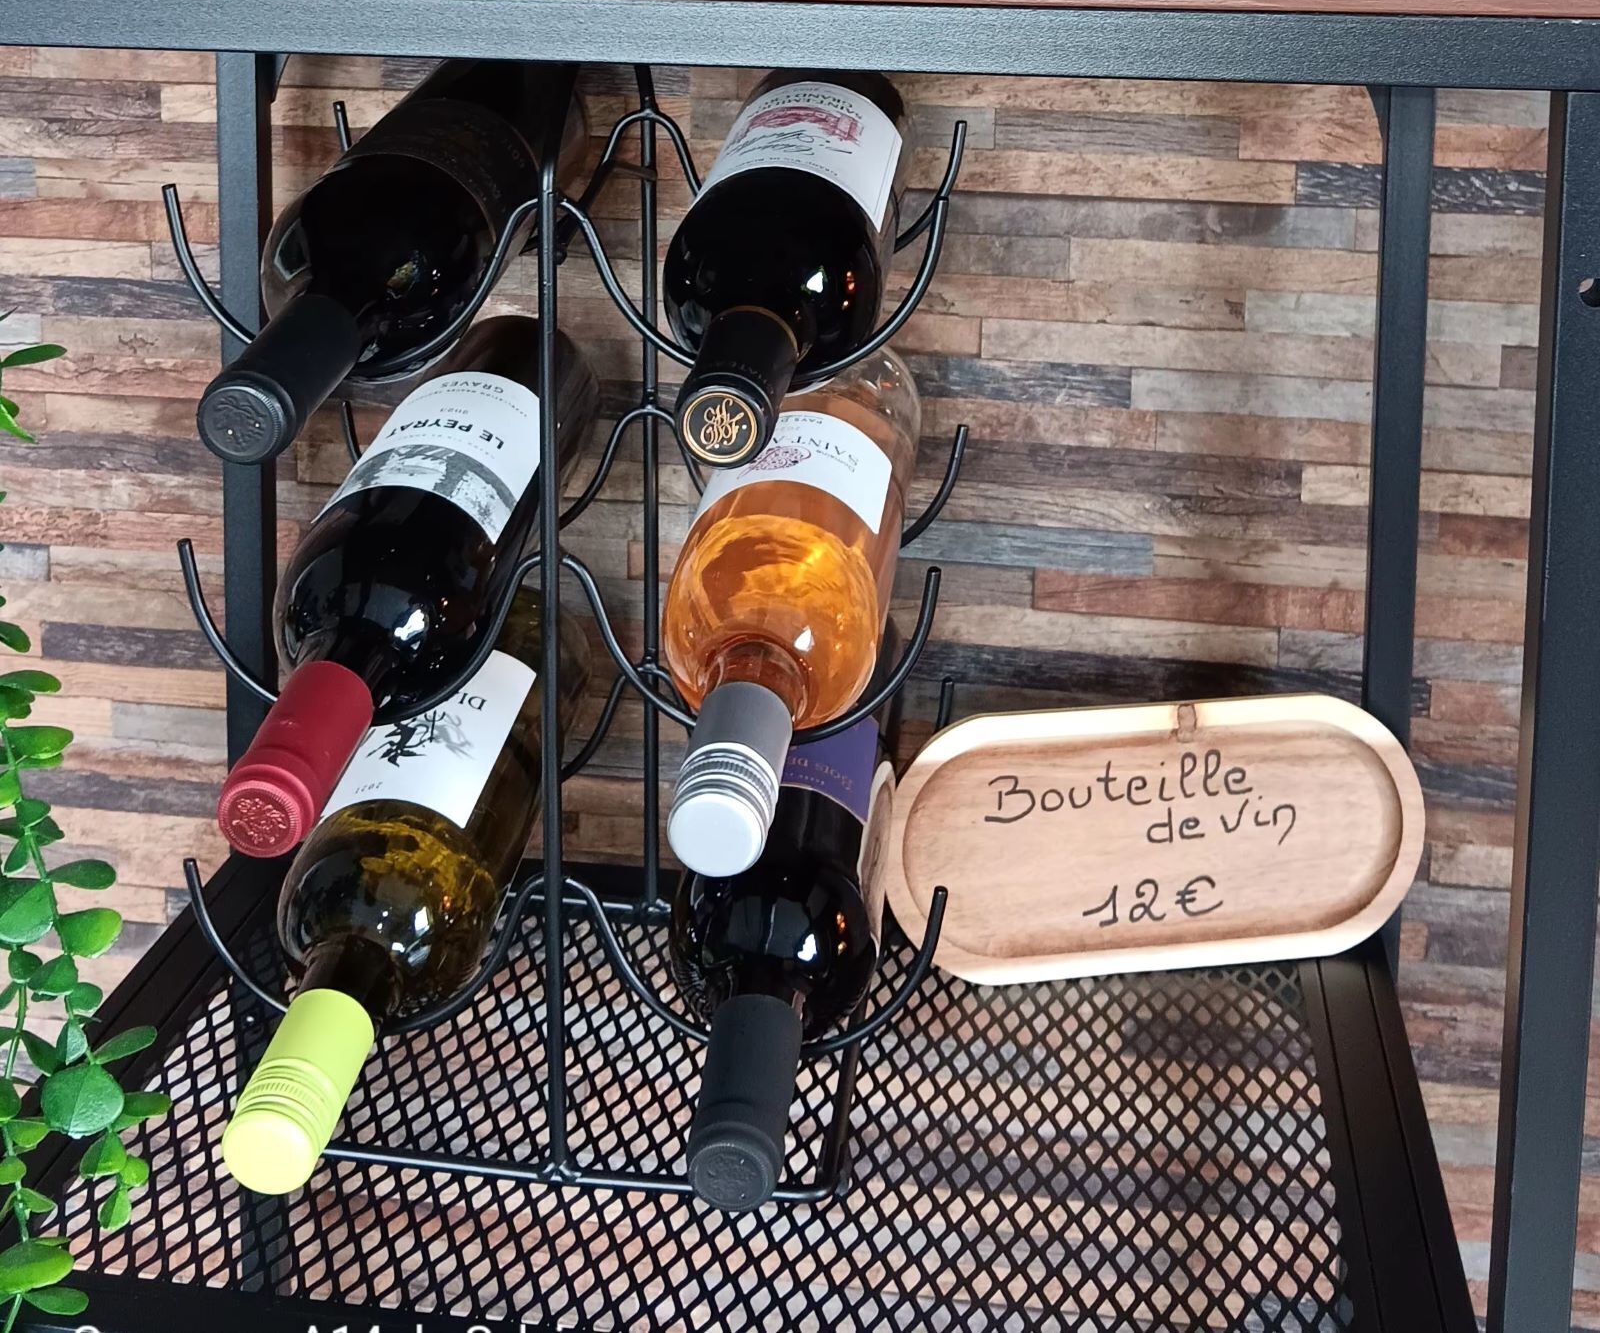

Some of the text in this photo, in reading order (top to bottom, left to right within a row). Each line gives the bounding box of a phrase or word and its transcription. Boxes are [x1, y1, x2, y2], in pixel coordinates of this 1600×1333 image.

[440, 380, 504, 394] GRAVES
[385, 418, 474, 439] PEYRAT
[478, 429, 505, 450] LE
[984, 749, 1254, 823] Bouteille
[1146, 807, 1206, 844] de
[1082, 874, 1224, 927] 12€
